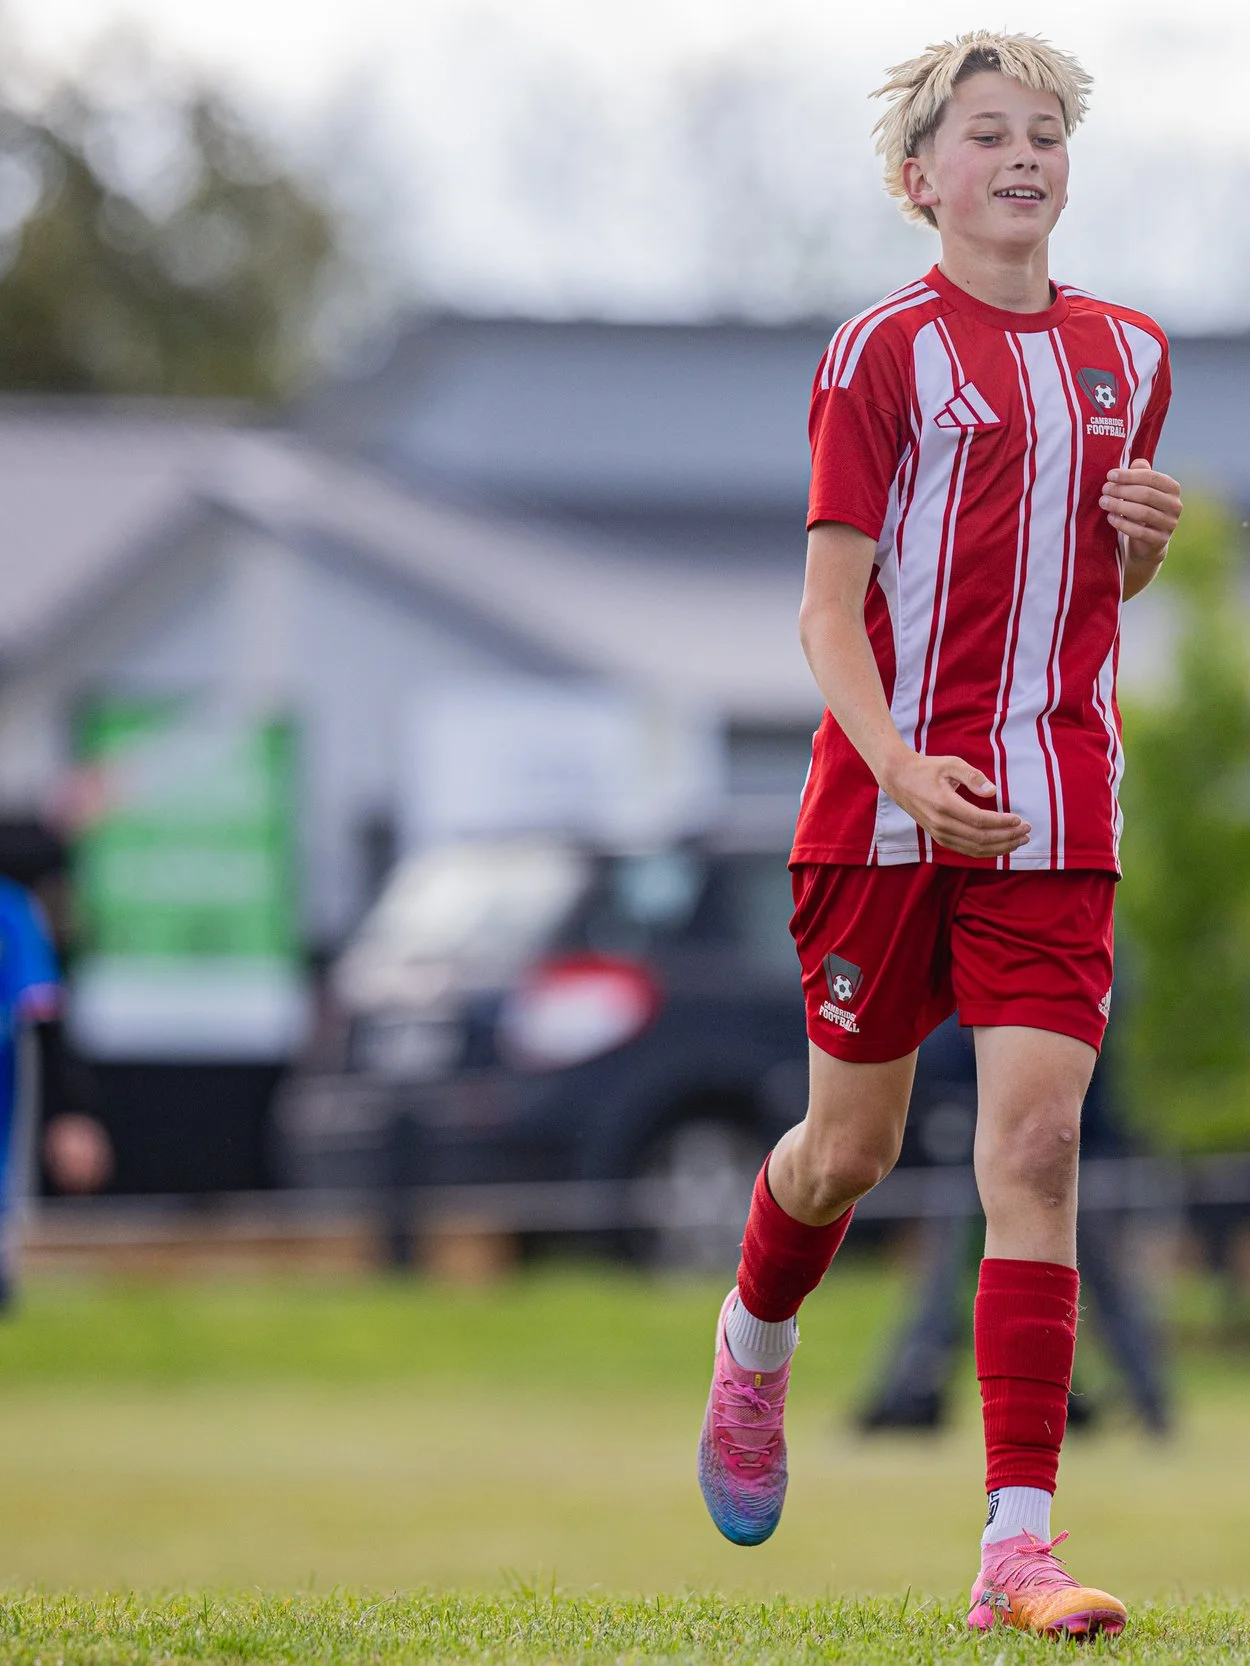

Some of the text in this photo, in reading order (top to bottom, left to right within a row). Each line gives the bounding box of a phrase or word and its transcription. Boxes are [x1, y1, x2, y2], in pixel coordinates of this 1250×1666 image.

[1090, 416, 1124, 427] CAMBRIDGE
[1086, 424, 1126, 438] FOOTBALL
[819, 1005, 860, 1033] FOOTBALL
